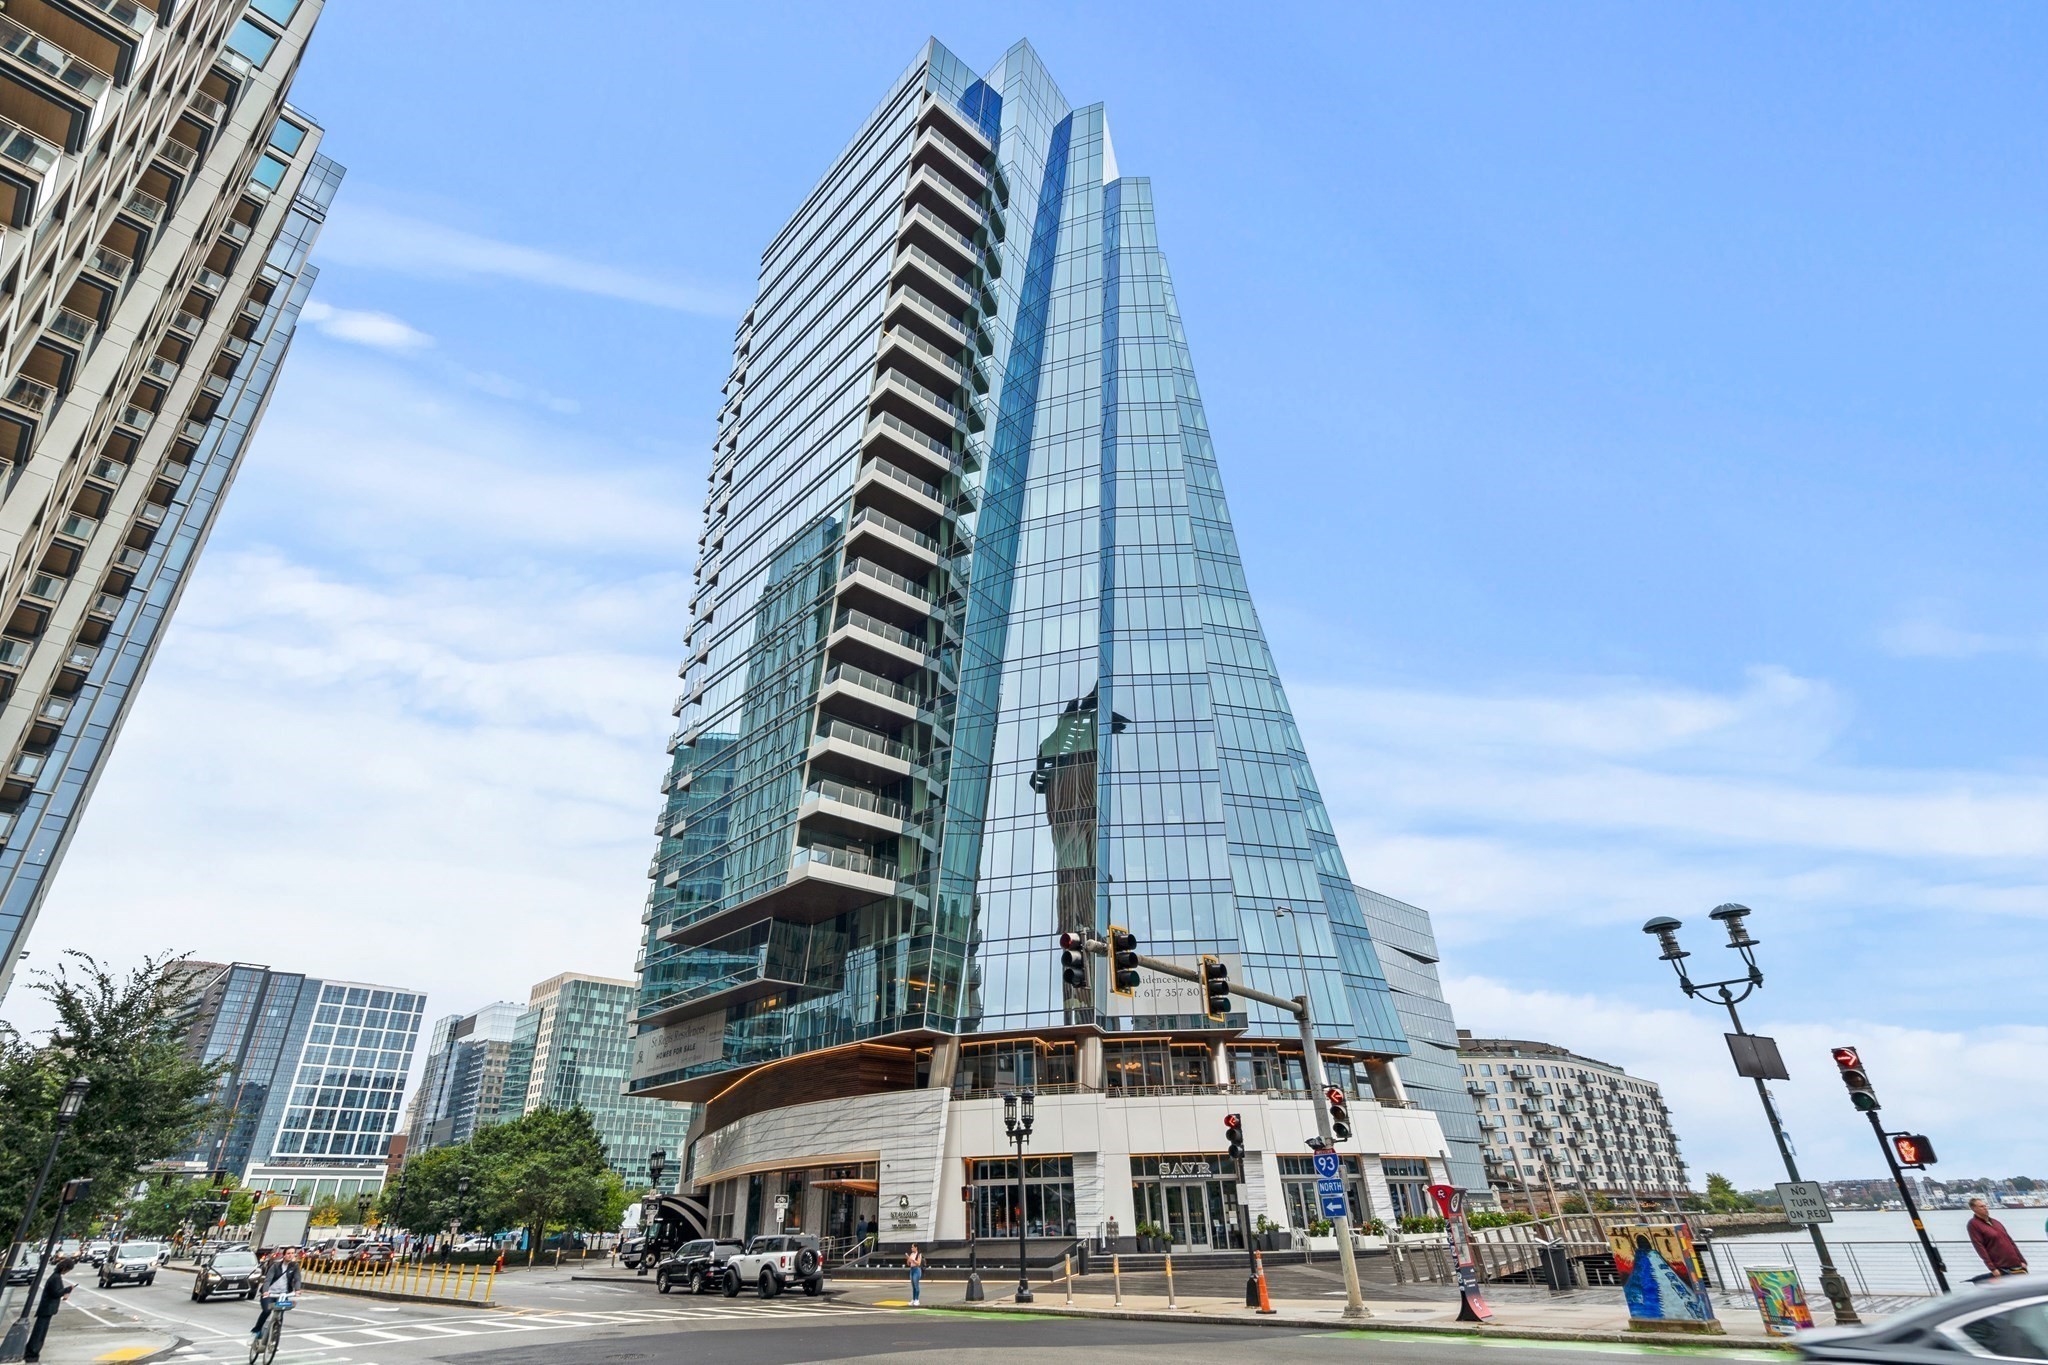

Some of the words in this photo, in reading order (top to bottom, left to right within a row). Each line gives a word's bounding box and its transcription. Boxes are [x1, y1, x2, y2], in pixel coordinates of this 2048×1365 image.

[1144, 988, 1161, 997] 617
[1165, 988, 1184, 997] 357
[674, 1025, 706, 1041] Residences
[655, 1049, 672, 1060] HOMES
[673, 1046, 683, 1056] FOR
[684, 1043, 696, 1053] SALE
[1159, 1162, 1211, 1174] SAVR
[1318, 1156, 1335, 1171] 93
[1320, 1181, 1342, 1191] NORTH
[1790, 1186, 1806, 1195] NO
[1790, 1198, 1817, 1207] TURN
[1790, 1210, 1804, 1219] ON
[1806, 1209, 1827, 1218] RED
